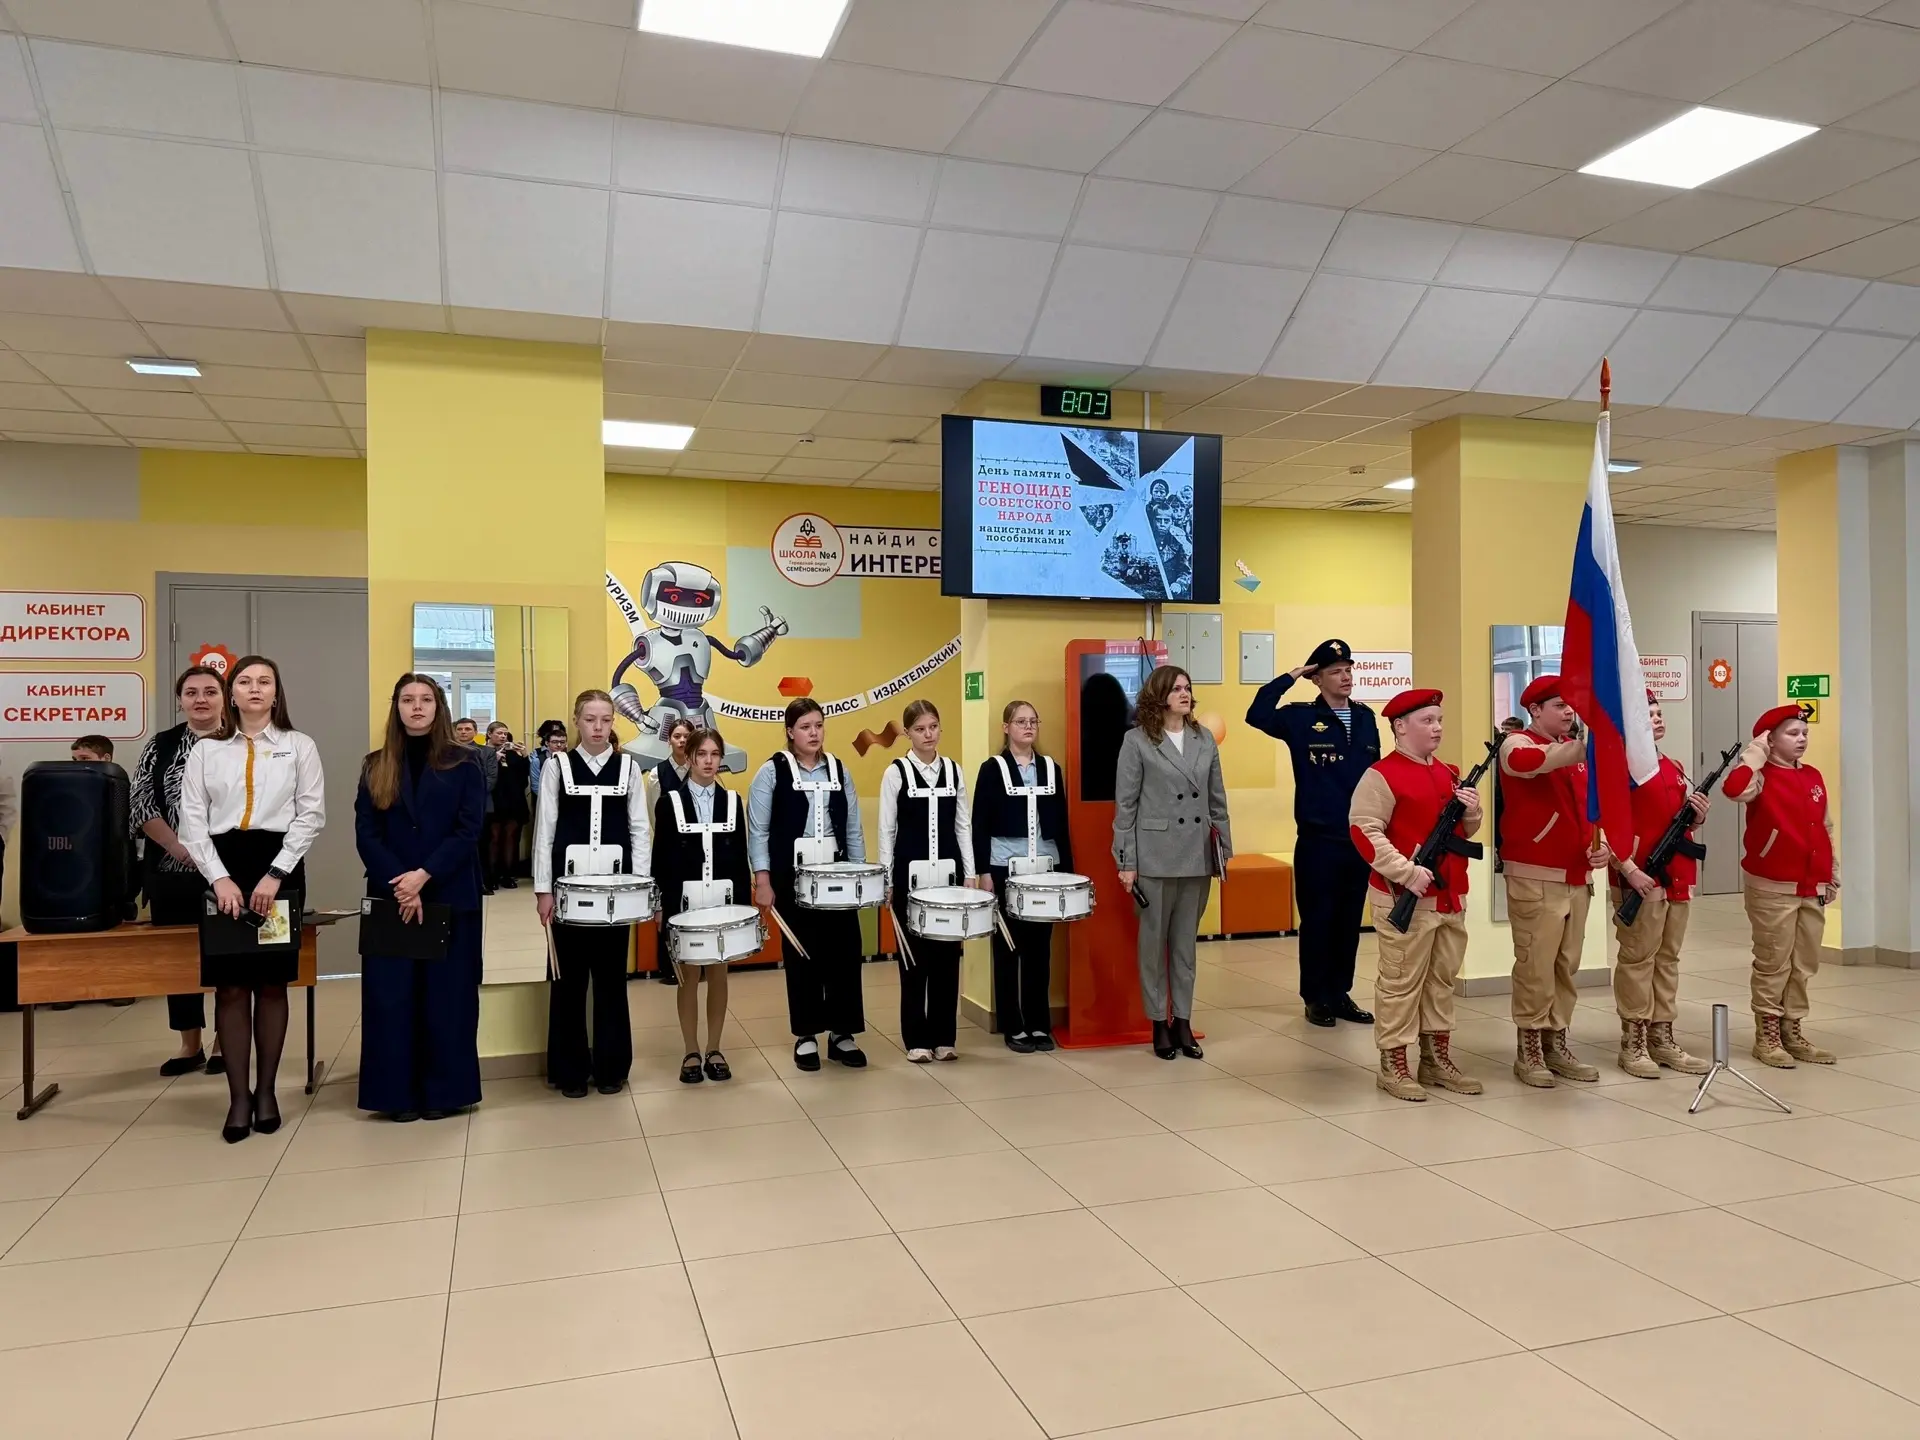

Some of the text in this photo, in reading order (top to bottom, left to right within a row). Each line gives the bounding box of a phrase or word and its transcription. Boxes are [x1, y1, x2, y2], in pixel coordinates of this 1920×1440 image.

[1061, 390, 1108, 415] 8:03
[978, 465, 1009, 476] День
[1014, 469, 1060, 479] памяти
[978, 481, 1072, 499] ГЕНОЦИДЕ
[978, 497, 1072, 510] СОВЕТСКОГО
[998, 511, 1053, 523] НАРОДА
[979, 525, 1044, 535] нацистами
[849, 532, 938, 548] НАЙДИ С
[986, 534, 1064, 545] пособниками
[779, 550, 837, 559] ШКОЛА №4
[851, 553, 941, 574] ИНТЕРЕ
[26, 603, 106, 616] КАБИНЕТ
[0, 625, 130, 642] ДИРЕКТОРА
[202, 661, 226, 669] 166
[1639, 658, 1668, 666] АБИНЕТ
[873, 642, 958, 700] ИЗДАТЕЛЬСКИЙ
[1360, 677, 1412, 687] ПЕДАГОГА
[27, 685, 106, 697] КАБИНЕТ
[4, 707, 127, 722] СЕКРЕТАРЯ
[720, 702, 784, 720] ИНЖЕНЕР
